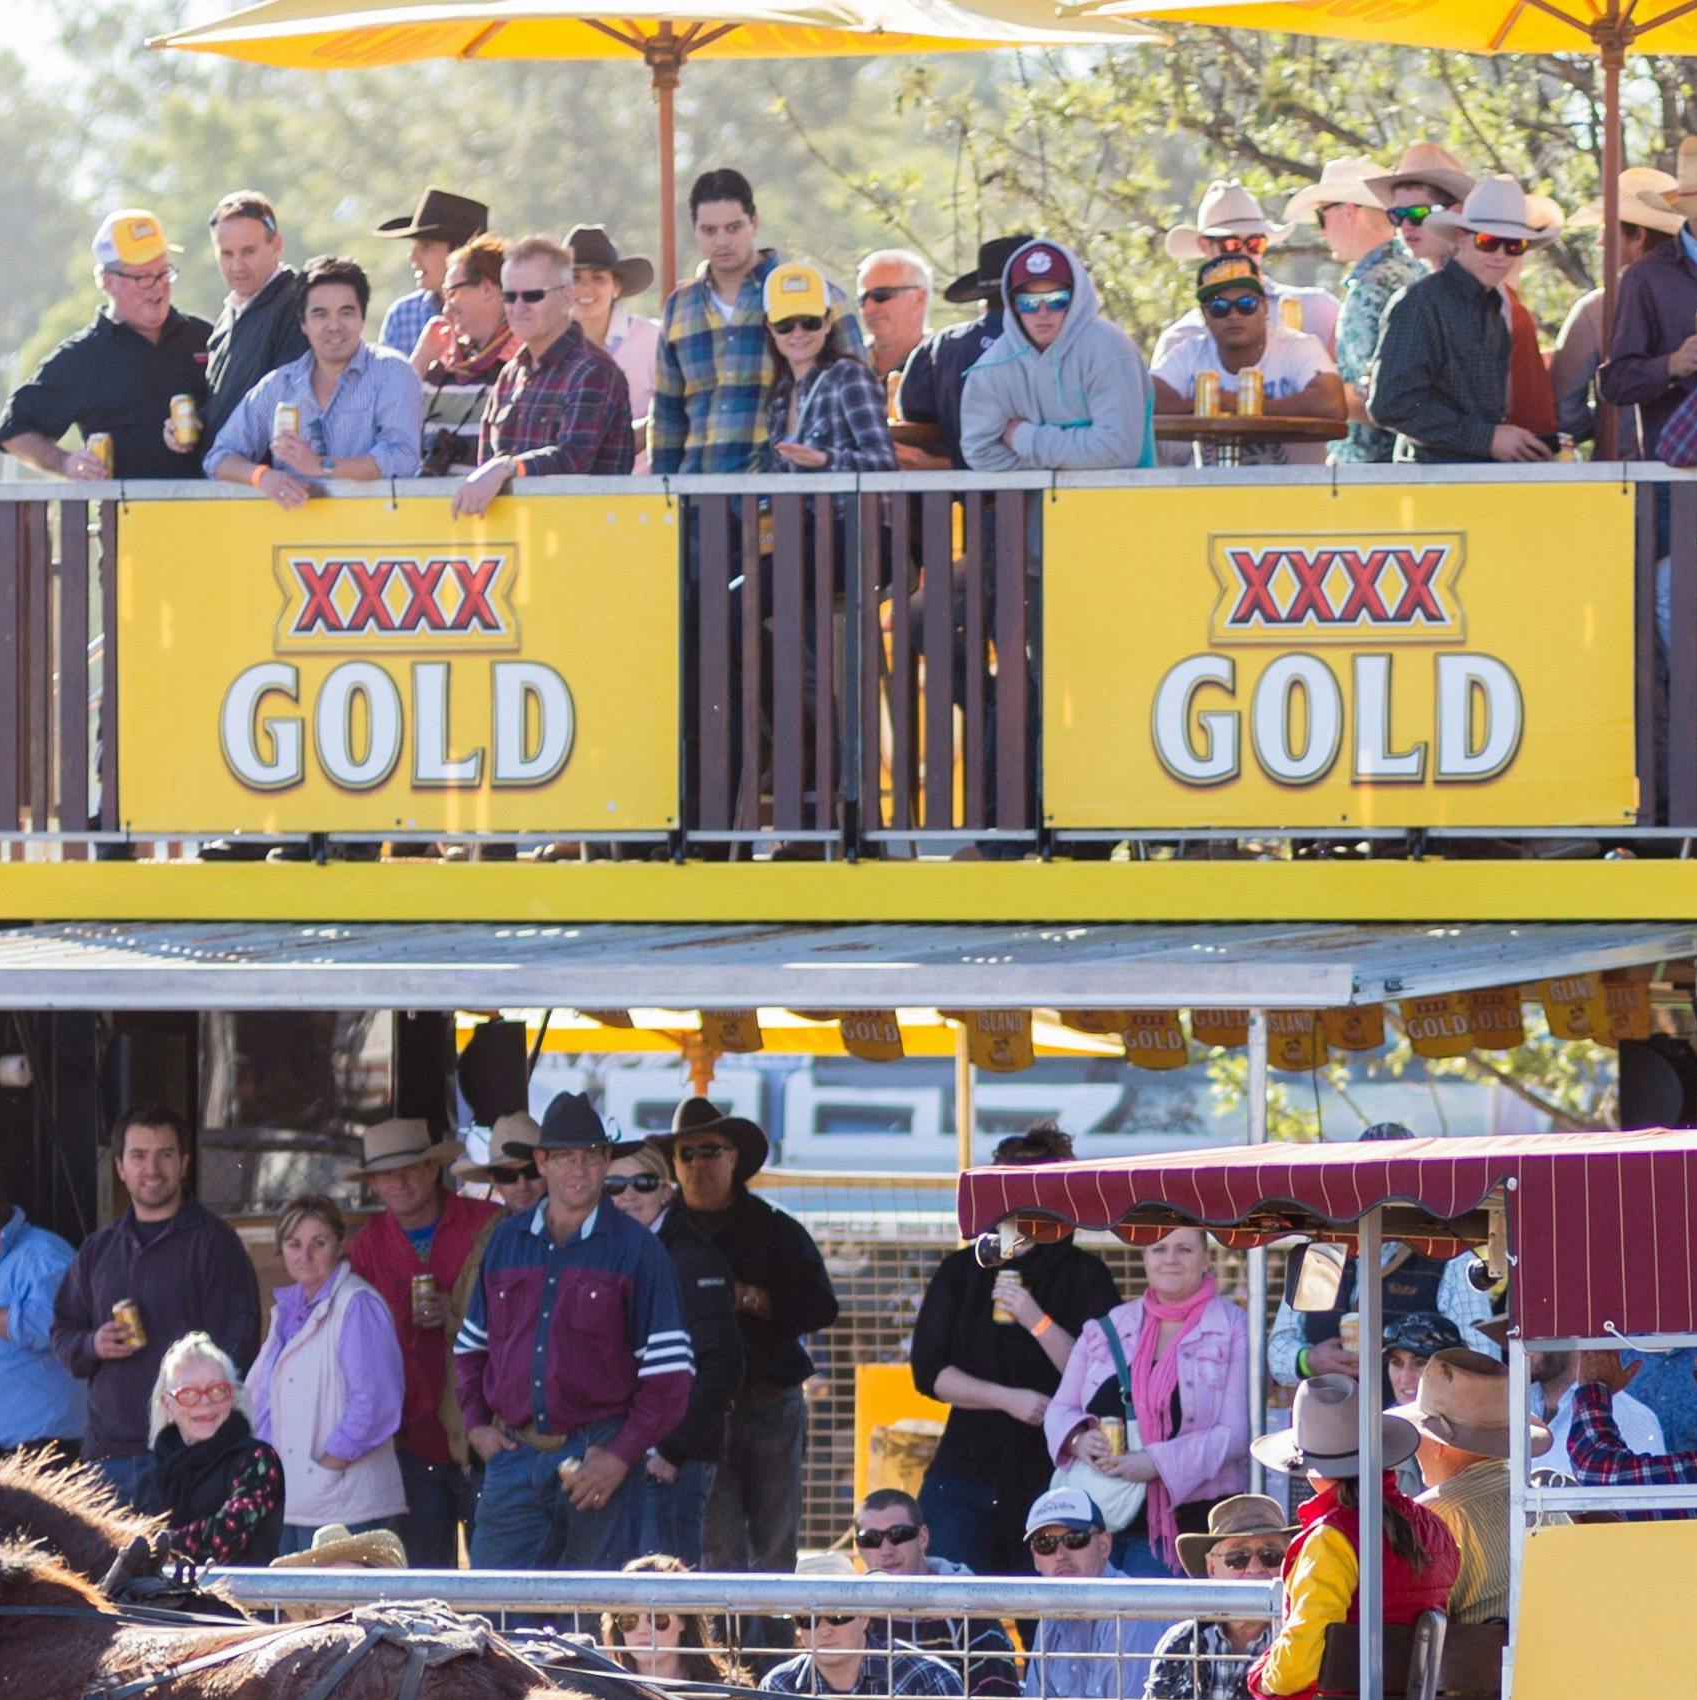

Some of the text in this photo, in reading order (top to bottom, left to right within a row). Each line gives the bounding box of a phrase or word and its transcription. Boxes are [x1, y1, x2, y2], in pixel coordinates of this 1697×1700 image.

[290, 556, 506, 637] XXXX
[1225, 546, 1455, 627] XXXX
[219, 661, 576, 791] GOLD
[1152, 652, 1524, 786] GOLD
[843, 1019, 899, 1042] GOLD
[977, 1011, 1022, 1033] ISLAND
[1123, 1028, 1183, 1052] GOLD
[1407, 1013, 1468, 1041] GOLD
